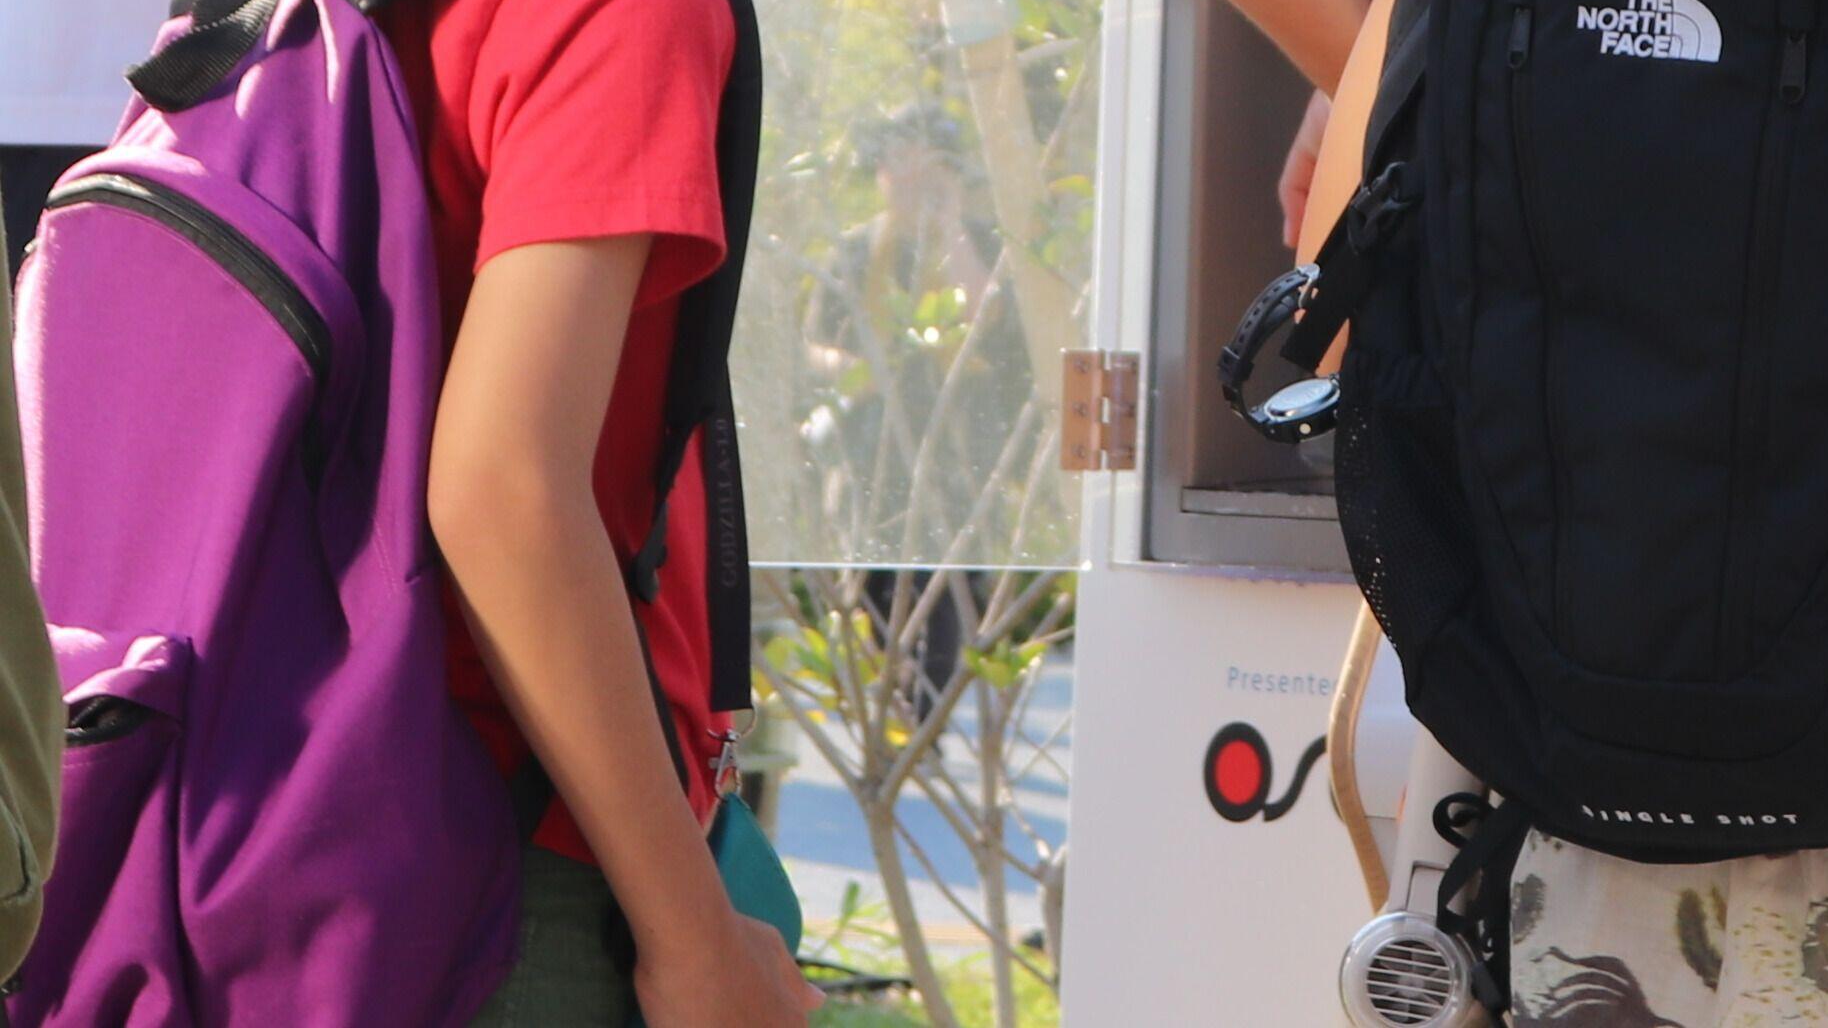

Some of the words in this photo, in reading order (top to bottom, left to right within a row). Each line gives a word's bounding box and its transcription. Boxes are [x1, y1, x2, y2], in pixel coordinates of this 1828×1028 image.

[1576, 5, 1673, 35] NORTH
[1600, 31, 1671, 59] FACE
[1226, 666, 1338, 696] Presente
[1203, 721, 1342, 824] OS
[1716, 813, 1798, 825] SHOT
